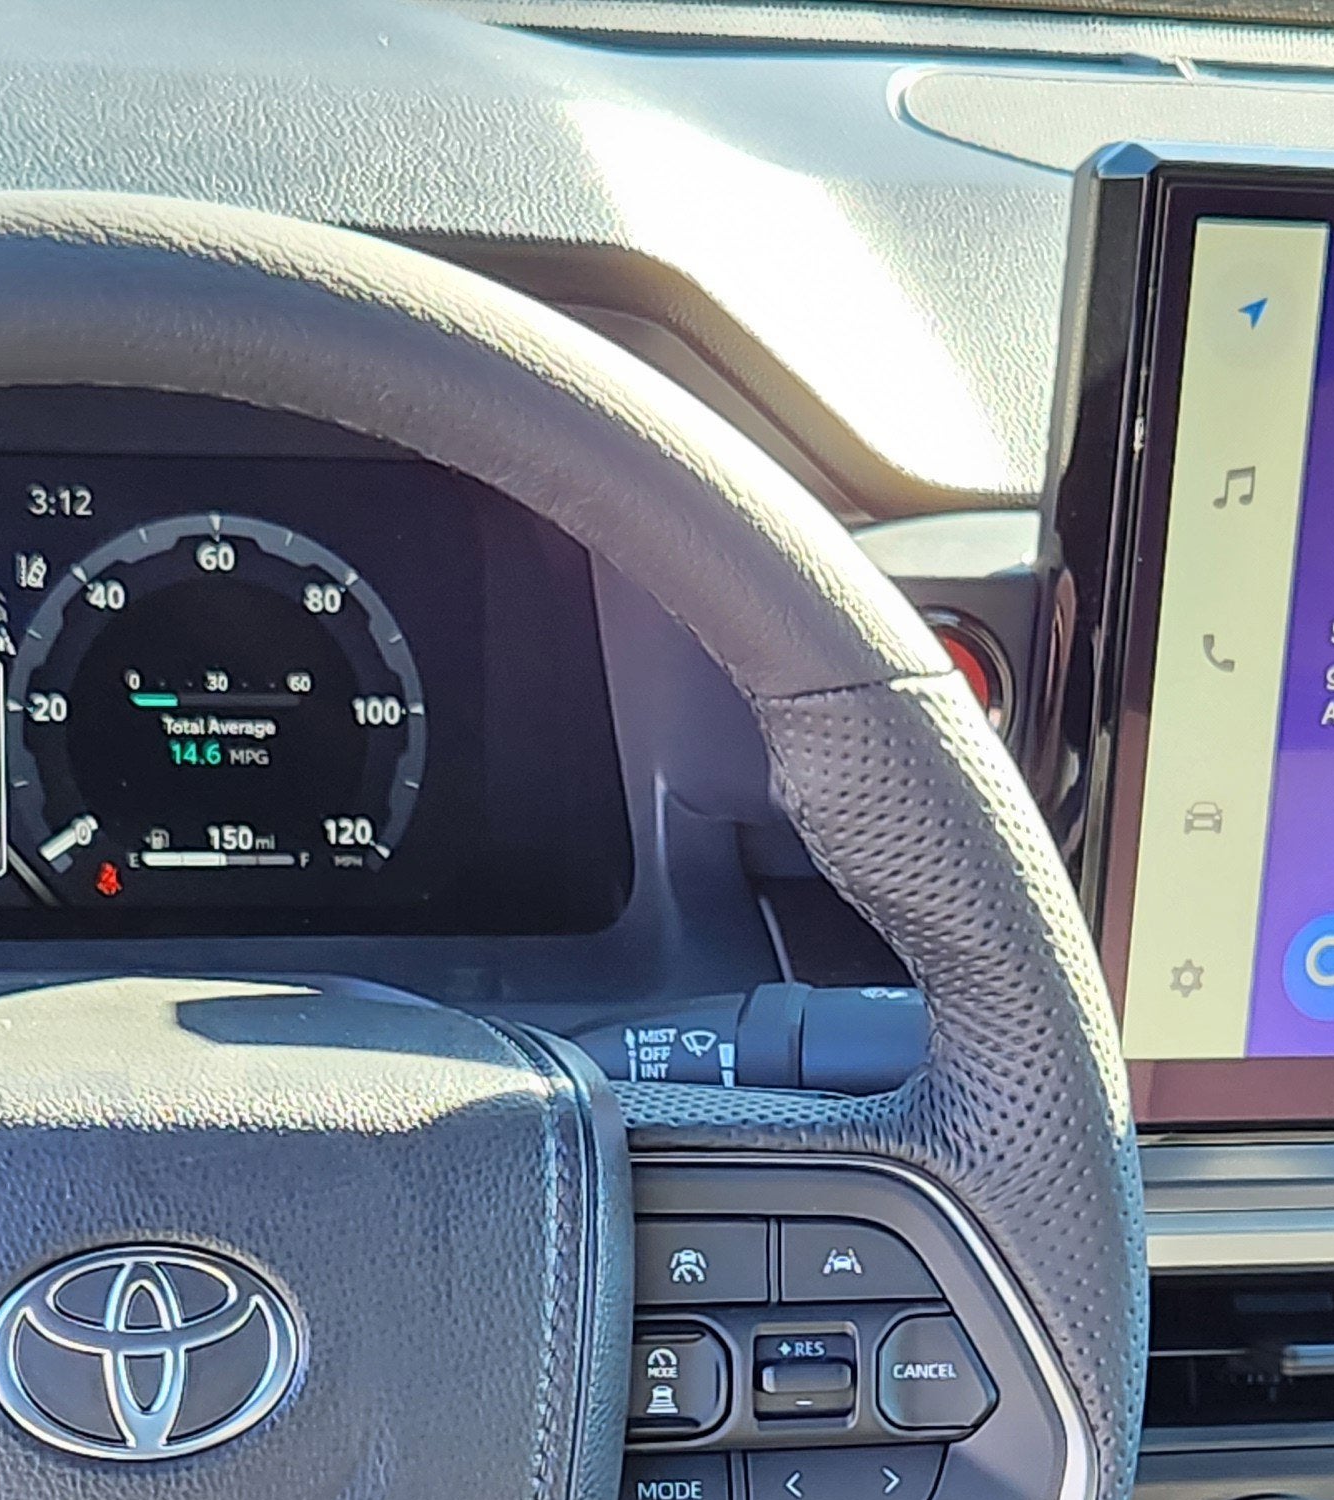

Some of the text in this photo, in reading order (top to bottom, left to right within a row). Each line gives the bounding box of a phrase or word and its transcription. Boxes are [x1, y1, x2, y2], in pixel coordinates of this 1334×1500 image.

[29, 488, 93, 516] 3:12
[198, 542, 235, 570] 60
[87, 581, 125, 609] 40
[305, 585, 341, 613] 80
[126, 670, 140, 690] 0
[206, 672, 228, 691] 30
[286, 672, 311, 691] 60
[30, 694, 67, 721] 20
[353, 697, 401, 726] 100
[163, 716, 275, 738] Total Average
[170, 742, 268, 765] 14.6 MPG
[207, 827, 275, 850] 150 mi
[324, 818, 372, 845] 120
[129, 853, 140, 868] E
[639, 1029, 677, 1043] MIST
[640, 1047, 670, 1061] OFF
[640, 1064, 668, 1078] INT
[648, 1367, 678, 1378] MODE
[893, 1363, 957, 1380] CANCEL
